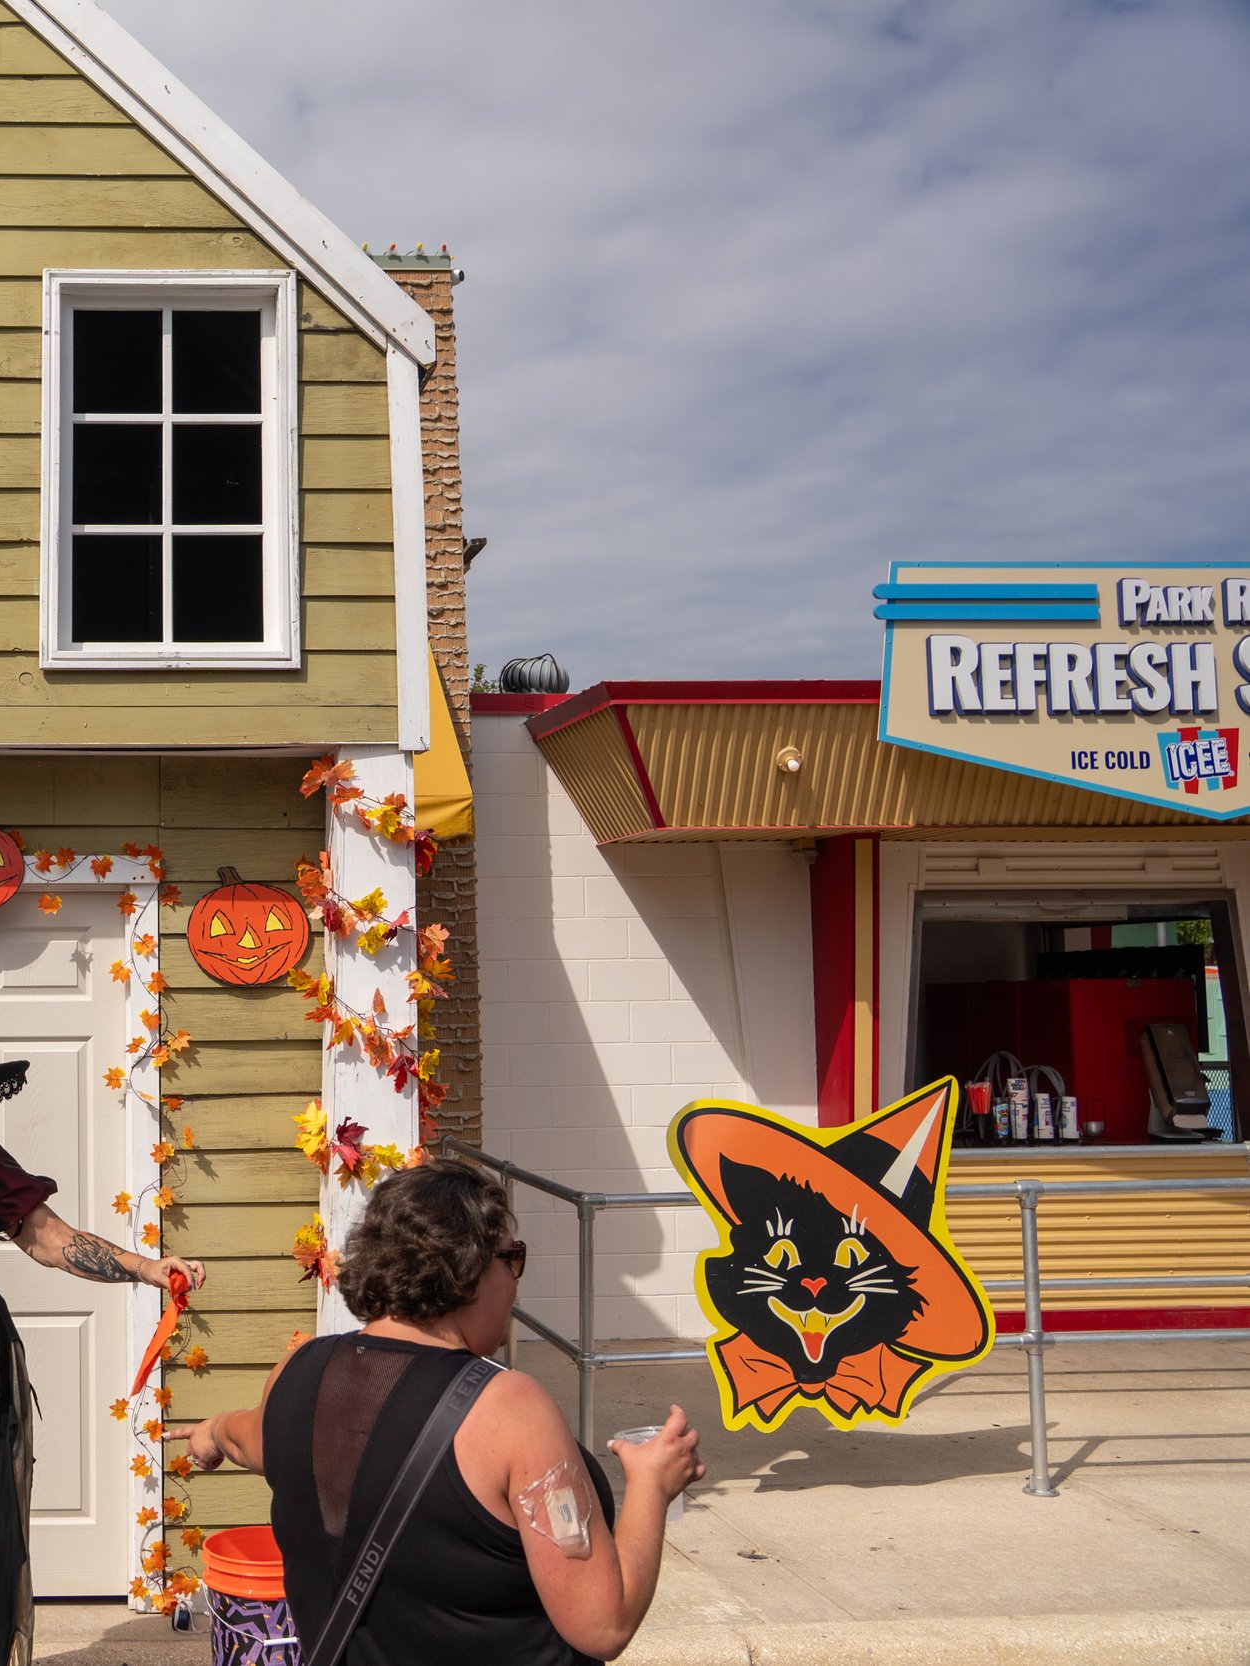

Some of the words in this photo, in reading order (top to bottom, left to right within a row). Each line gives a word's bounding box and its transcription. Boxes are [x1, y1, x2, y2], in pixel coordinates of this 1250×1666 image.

[1071, 751, 1098, 770] ICE
[1105, 751, 1150, 770] COLD
[1166, 738, 1231, 782] ICEE
[346, 1541, 385, 1606] FENDI
